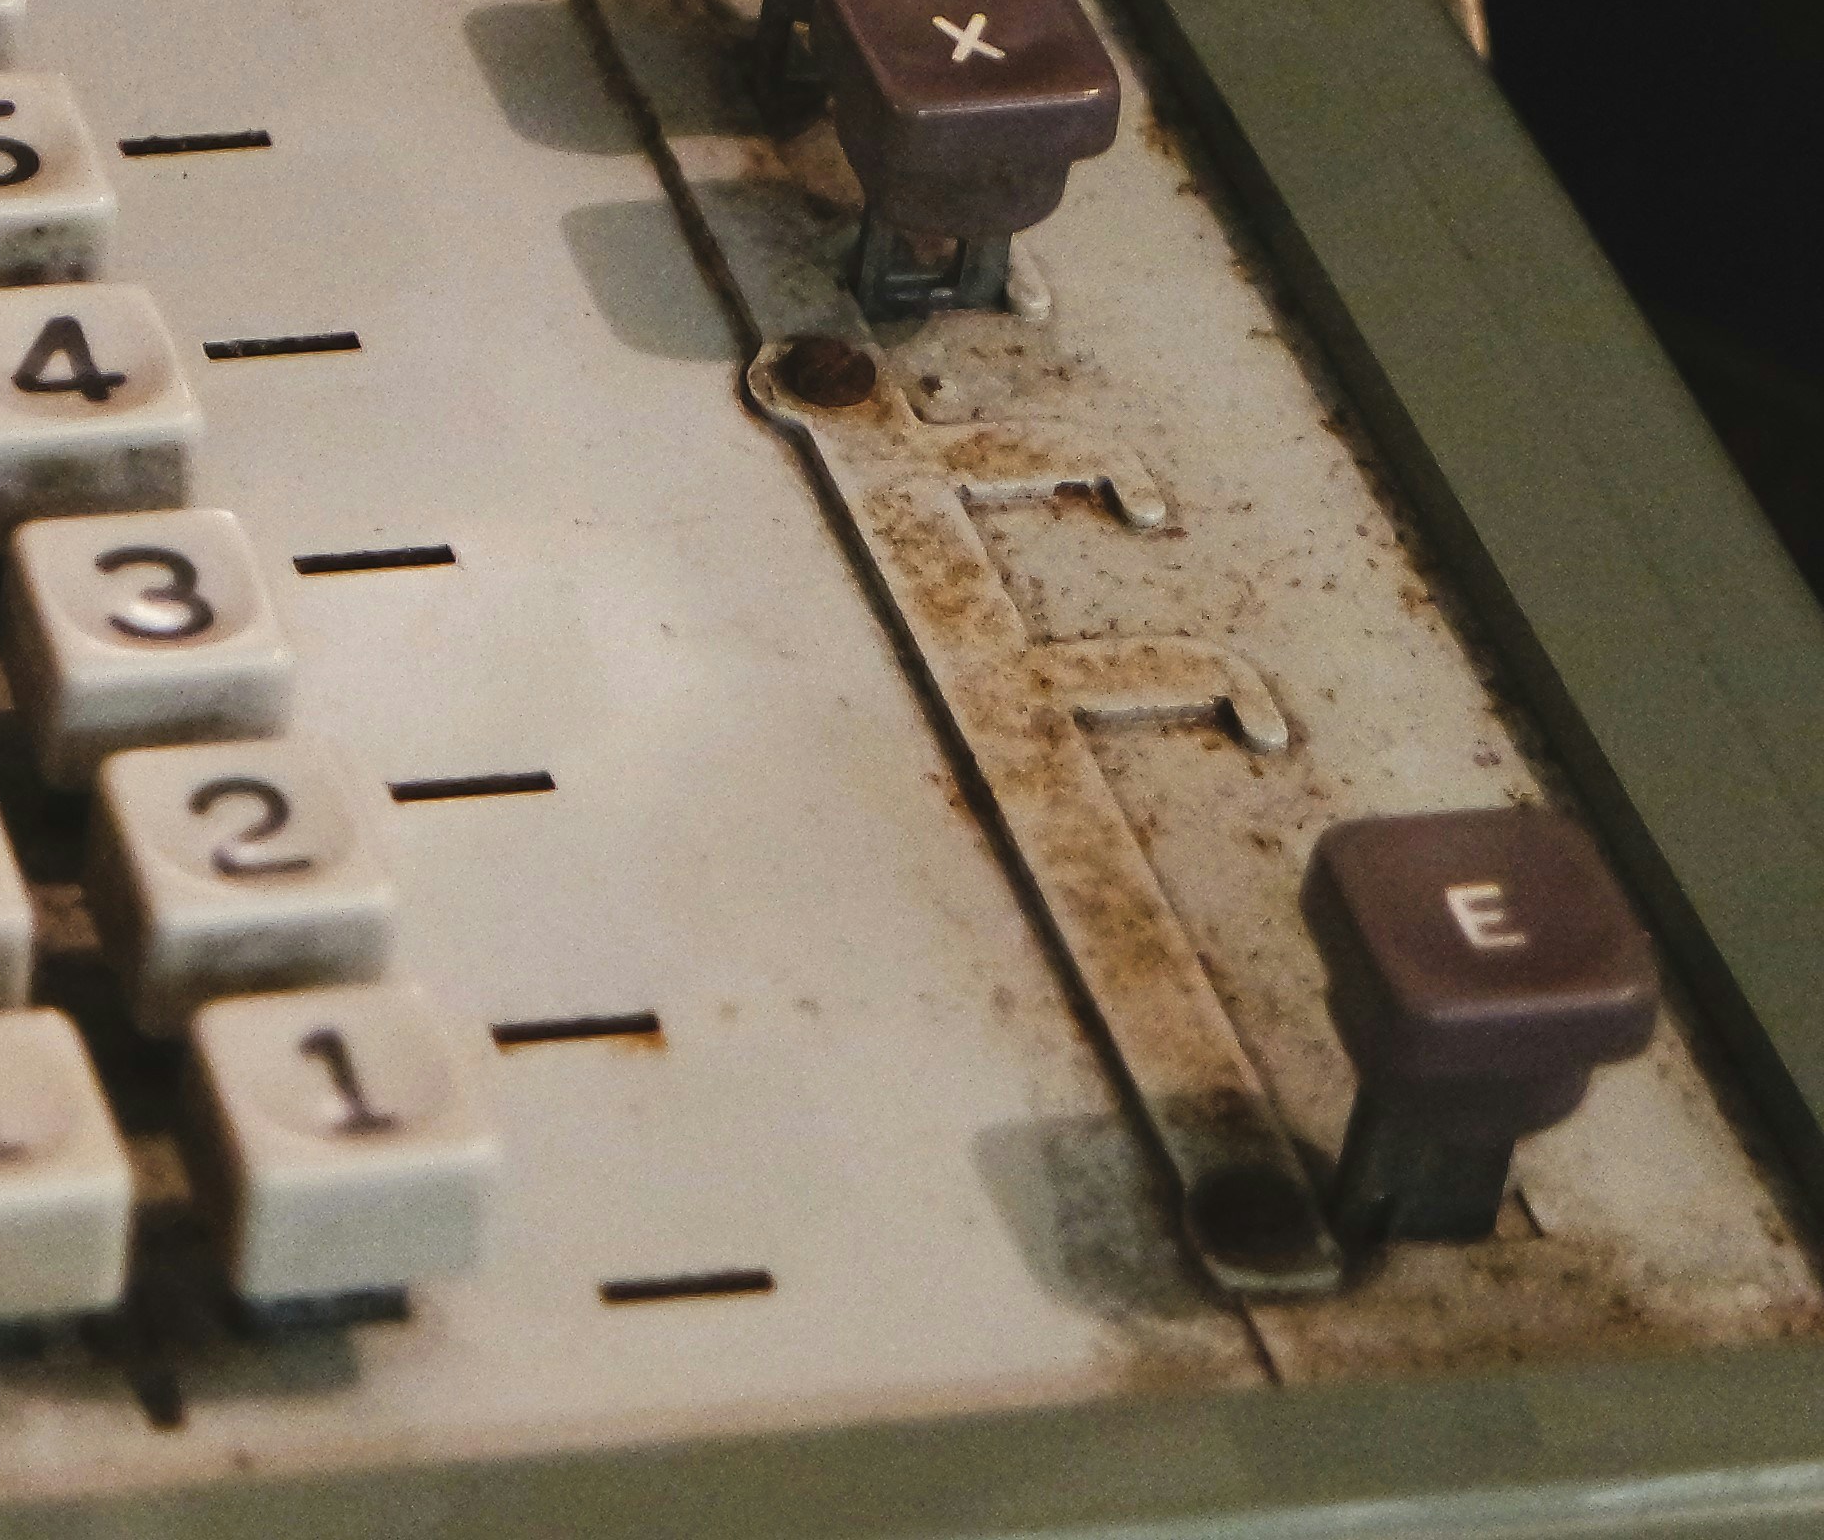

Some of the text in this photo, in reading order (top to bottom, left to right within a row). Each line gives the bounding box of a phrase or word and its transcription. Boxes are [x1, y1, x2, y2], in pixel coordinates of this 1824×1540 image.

[12, 315, 125, 401] 4
[96, 547, 214, 640] 3
[188, 778, 310, 878] 2
[1445, 884, 1526, 952] E
[297, 1029, 397, 1137] 1
